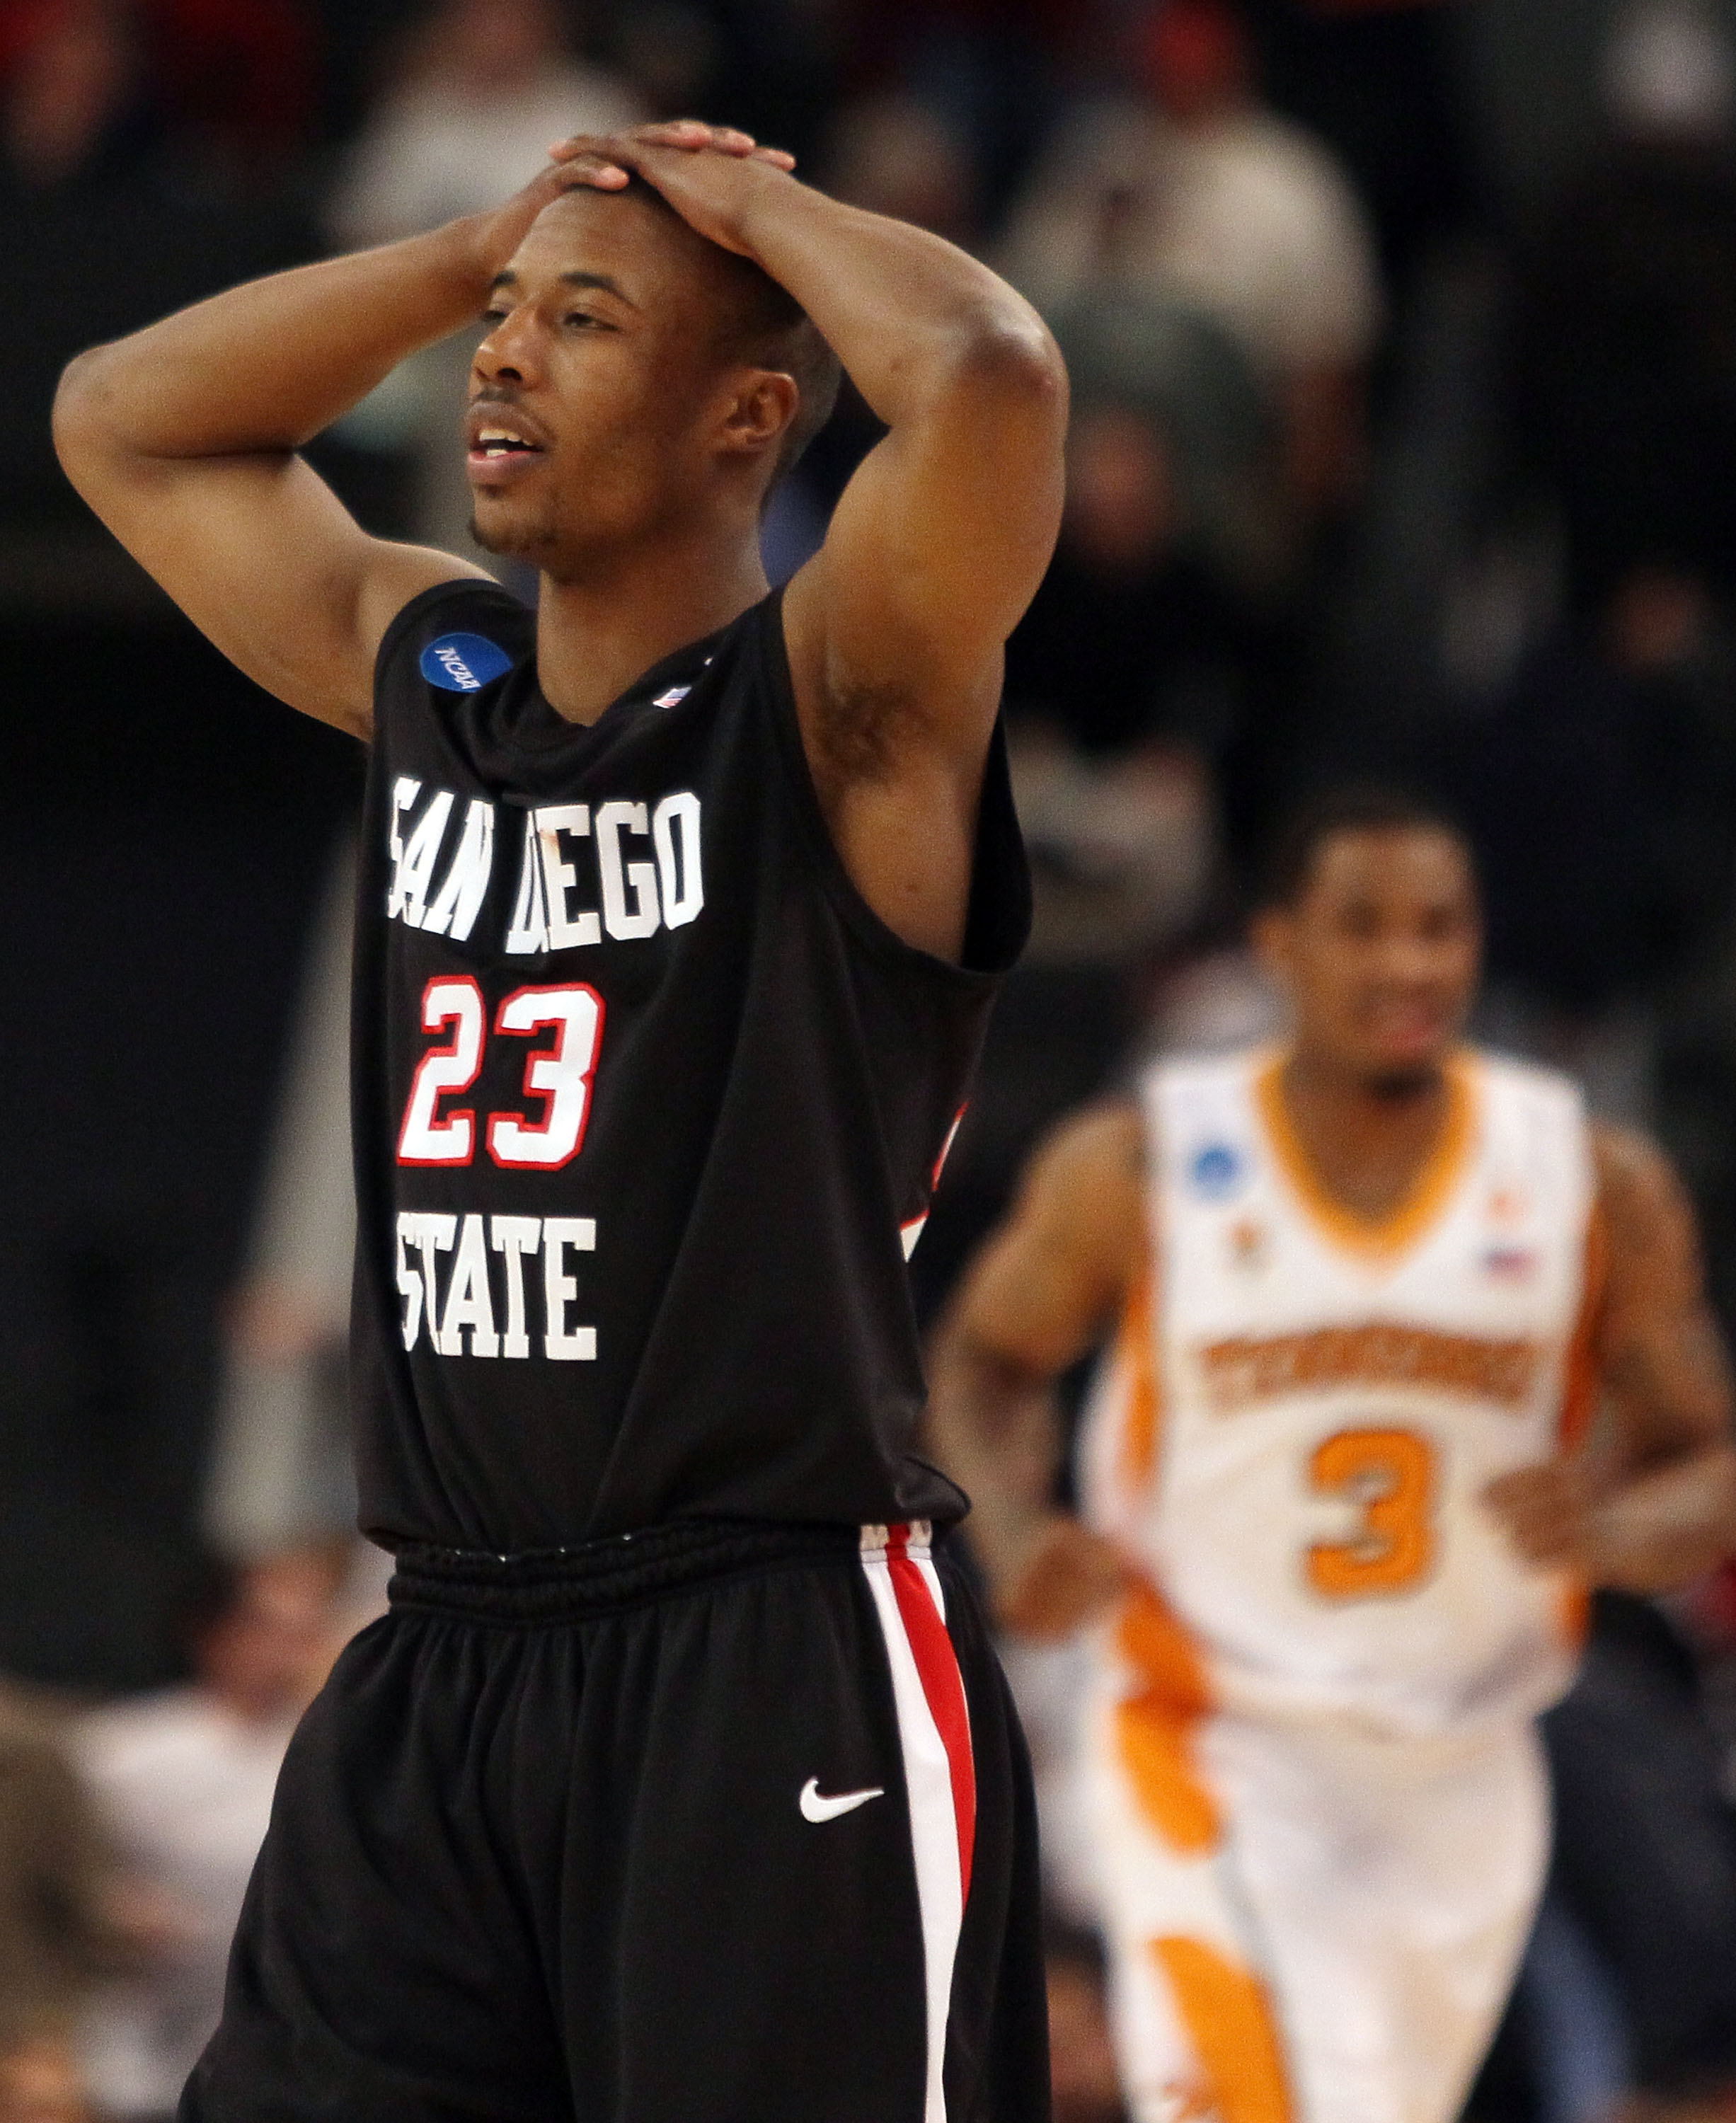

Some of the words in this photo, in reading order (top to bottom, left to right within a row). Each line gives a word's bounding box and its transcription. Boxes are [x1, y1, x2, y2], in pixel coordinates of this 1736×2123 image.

[434, 646, 483, 690] NCAA
[505, 791, 705, 954] DEGO
[396, 974, 607, 1172] 23
[396, 1211, 597, 1362] STATE
[1304, 1424, 1439, 1601] 3
